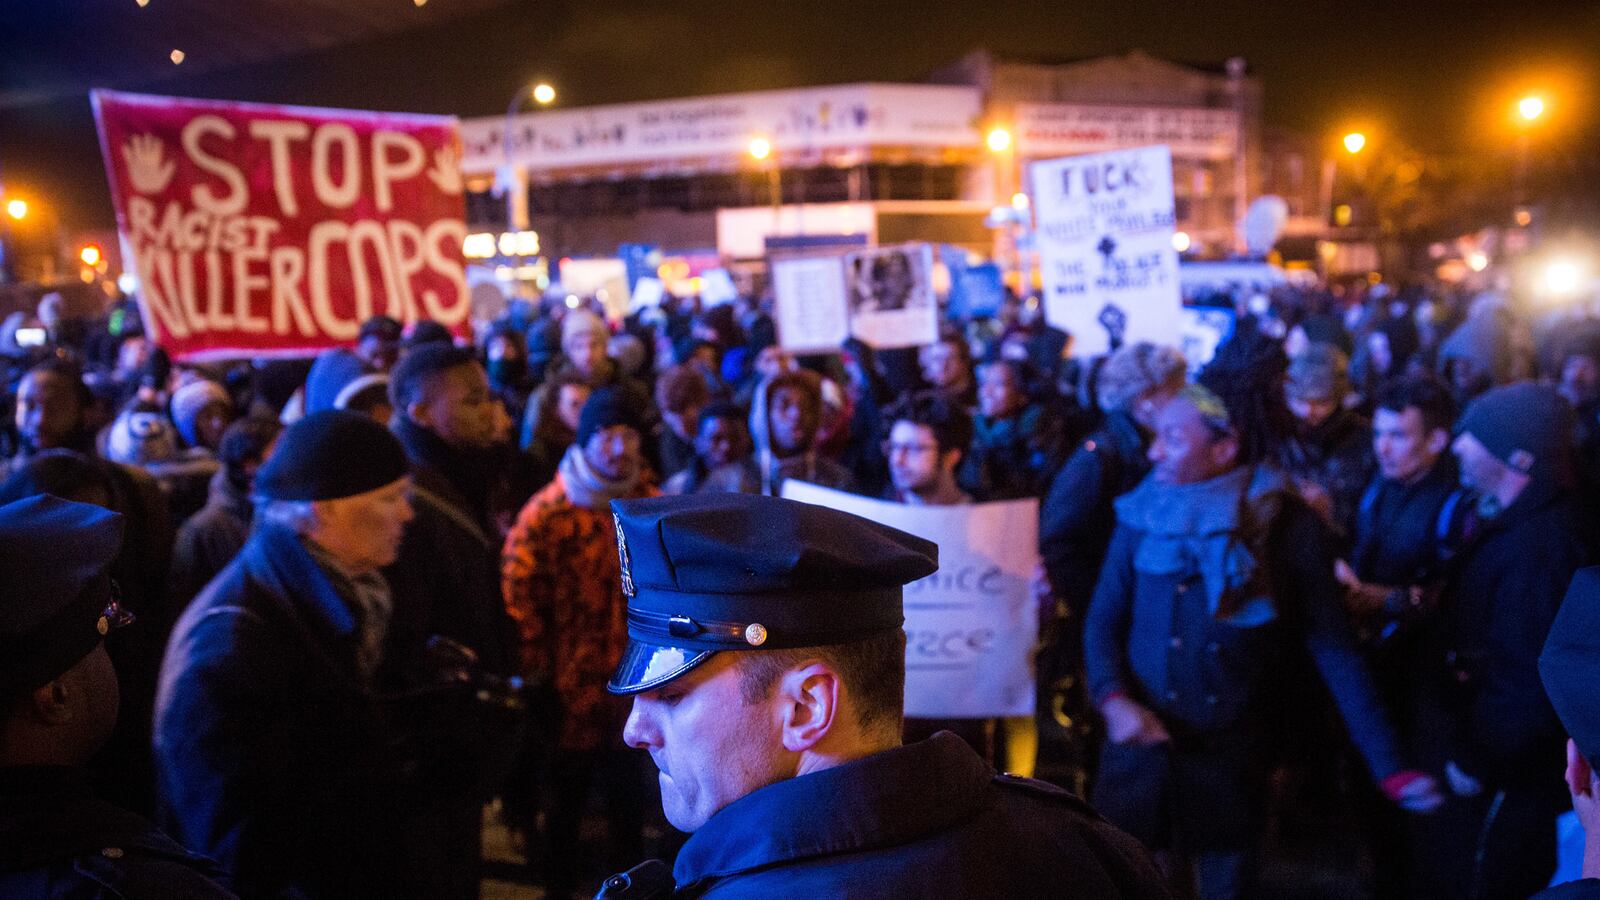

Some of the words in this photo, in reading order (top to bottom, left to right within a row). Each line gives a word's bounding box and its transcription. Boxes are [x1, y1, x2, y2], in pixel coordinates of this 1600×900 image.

[182, 116, 425, 216] STOP
[129, 196, 281, 256] RACIST
[136, 245, 318, 338] KILLER
[309, 220, 469, 338] COPS
